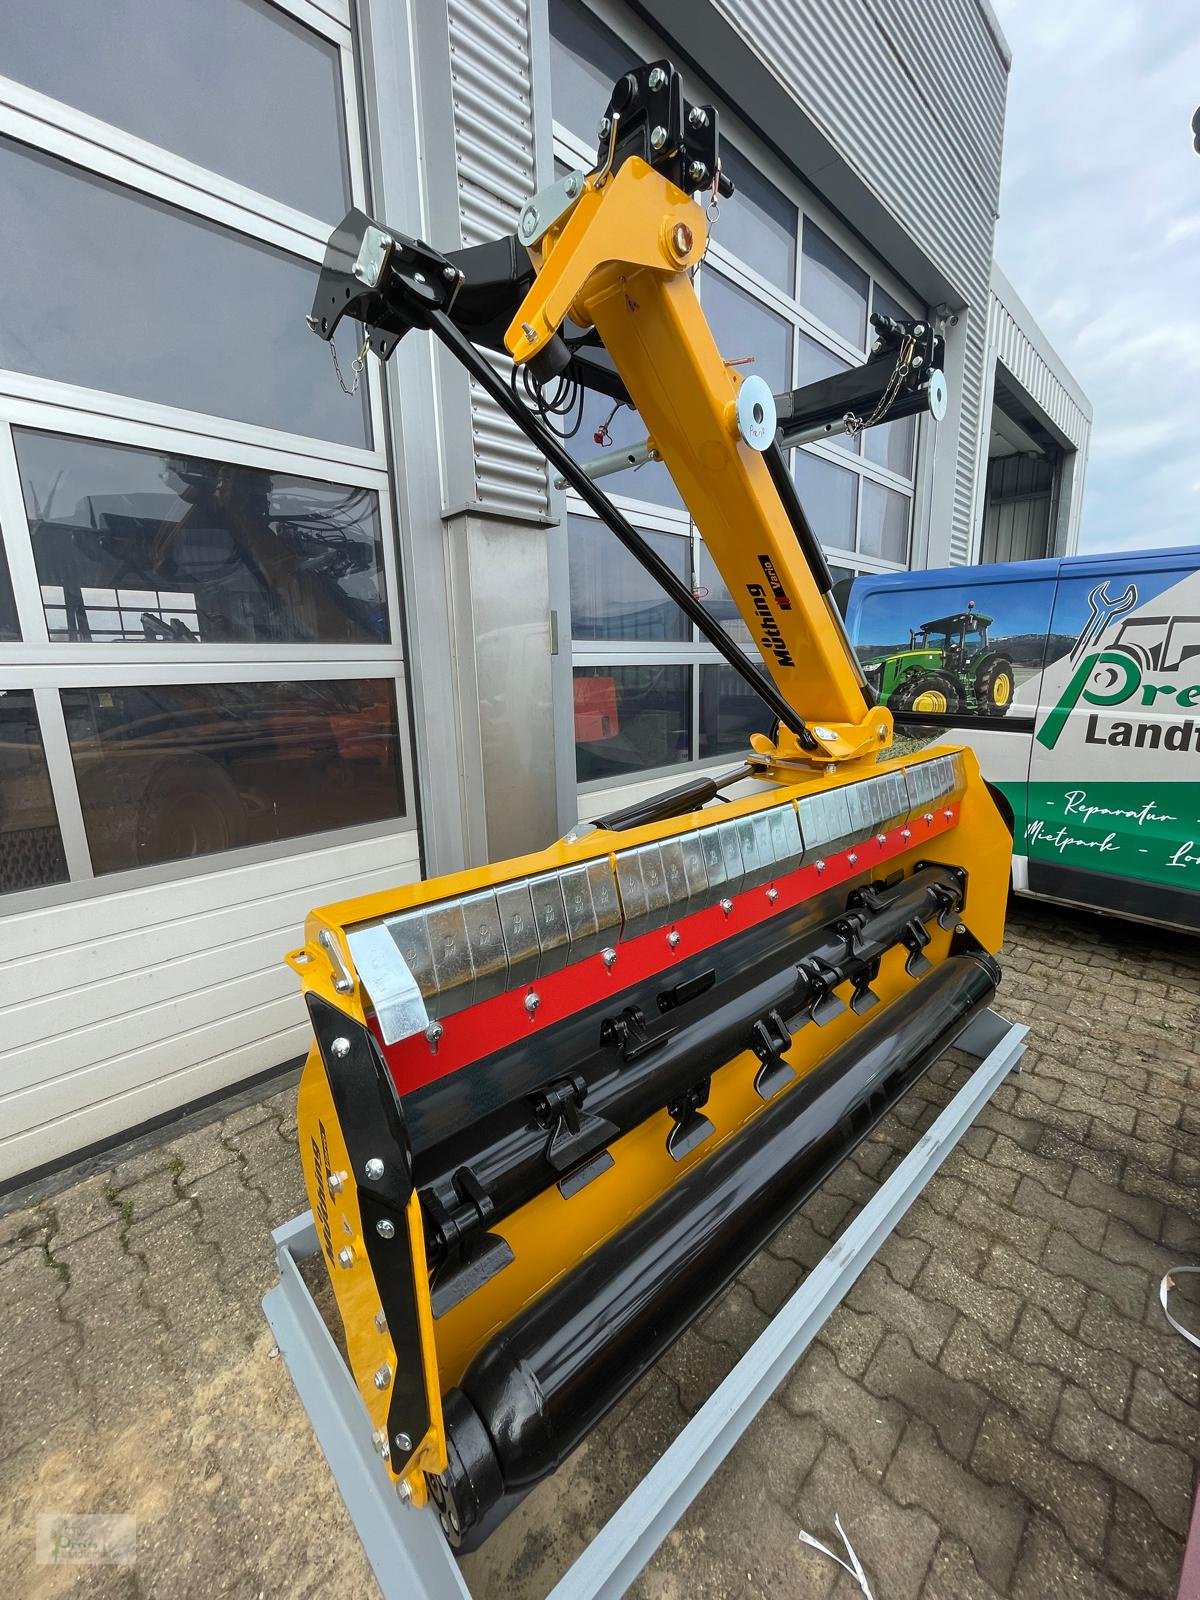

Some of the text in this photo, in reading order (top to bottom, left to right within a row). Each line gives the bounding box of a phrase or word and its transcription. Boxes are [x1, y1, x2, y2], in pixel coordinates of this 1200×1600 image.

[764, 561, 781, 589] Vario
[746, 584, 796, 667] Müthing
[1064, 790, 1177, 826] Reparatur
[1024, 820, 1121, 854] Mietpark
